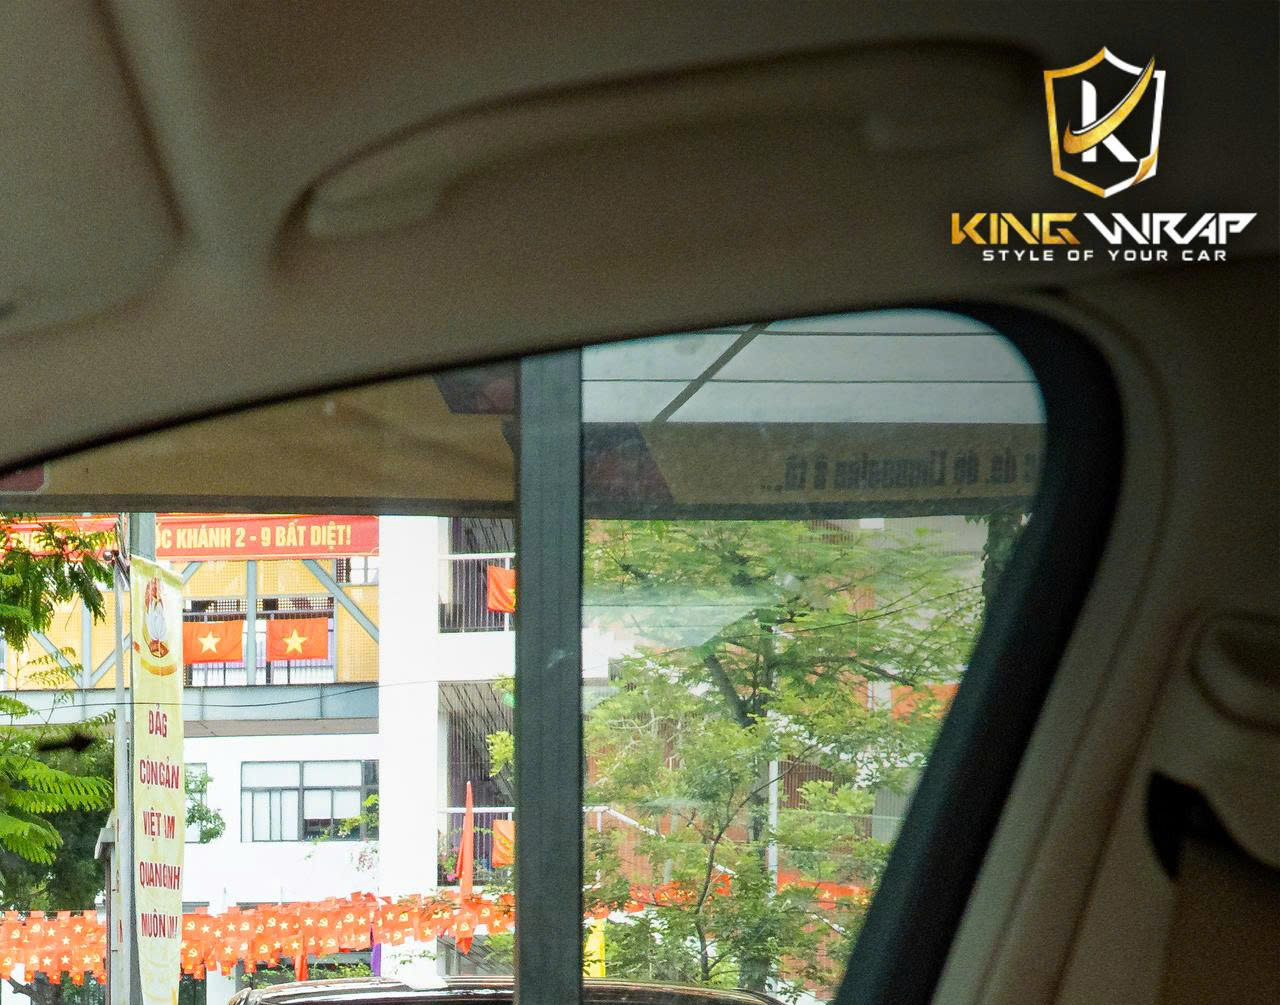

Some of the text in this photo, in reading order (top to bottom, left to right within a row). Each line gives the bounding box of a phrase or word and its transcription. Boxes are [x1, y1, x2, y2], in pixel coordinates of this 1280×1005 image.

[176, 524, 232, 549] KHÁNH
[235, 527, 245, 548] 2
[261, 526, 271, 547] 9
[275, 519, 307, 547] BẤT
[310, 521, 352, 551] DIỆT!
[143, 807, 161, 841] VIỆT
[141, 908, 166, 938] MUÔN
